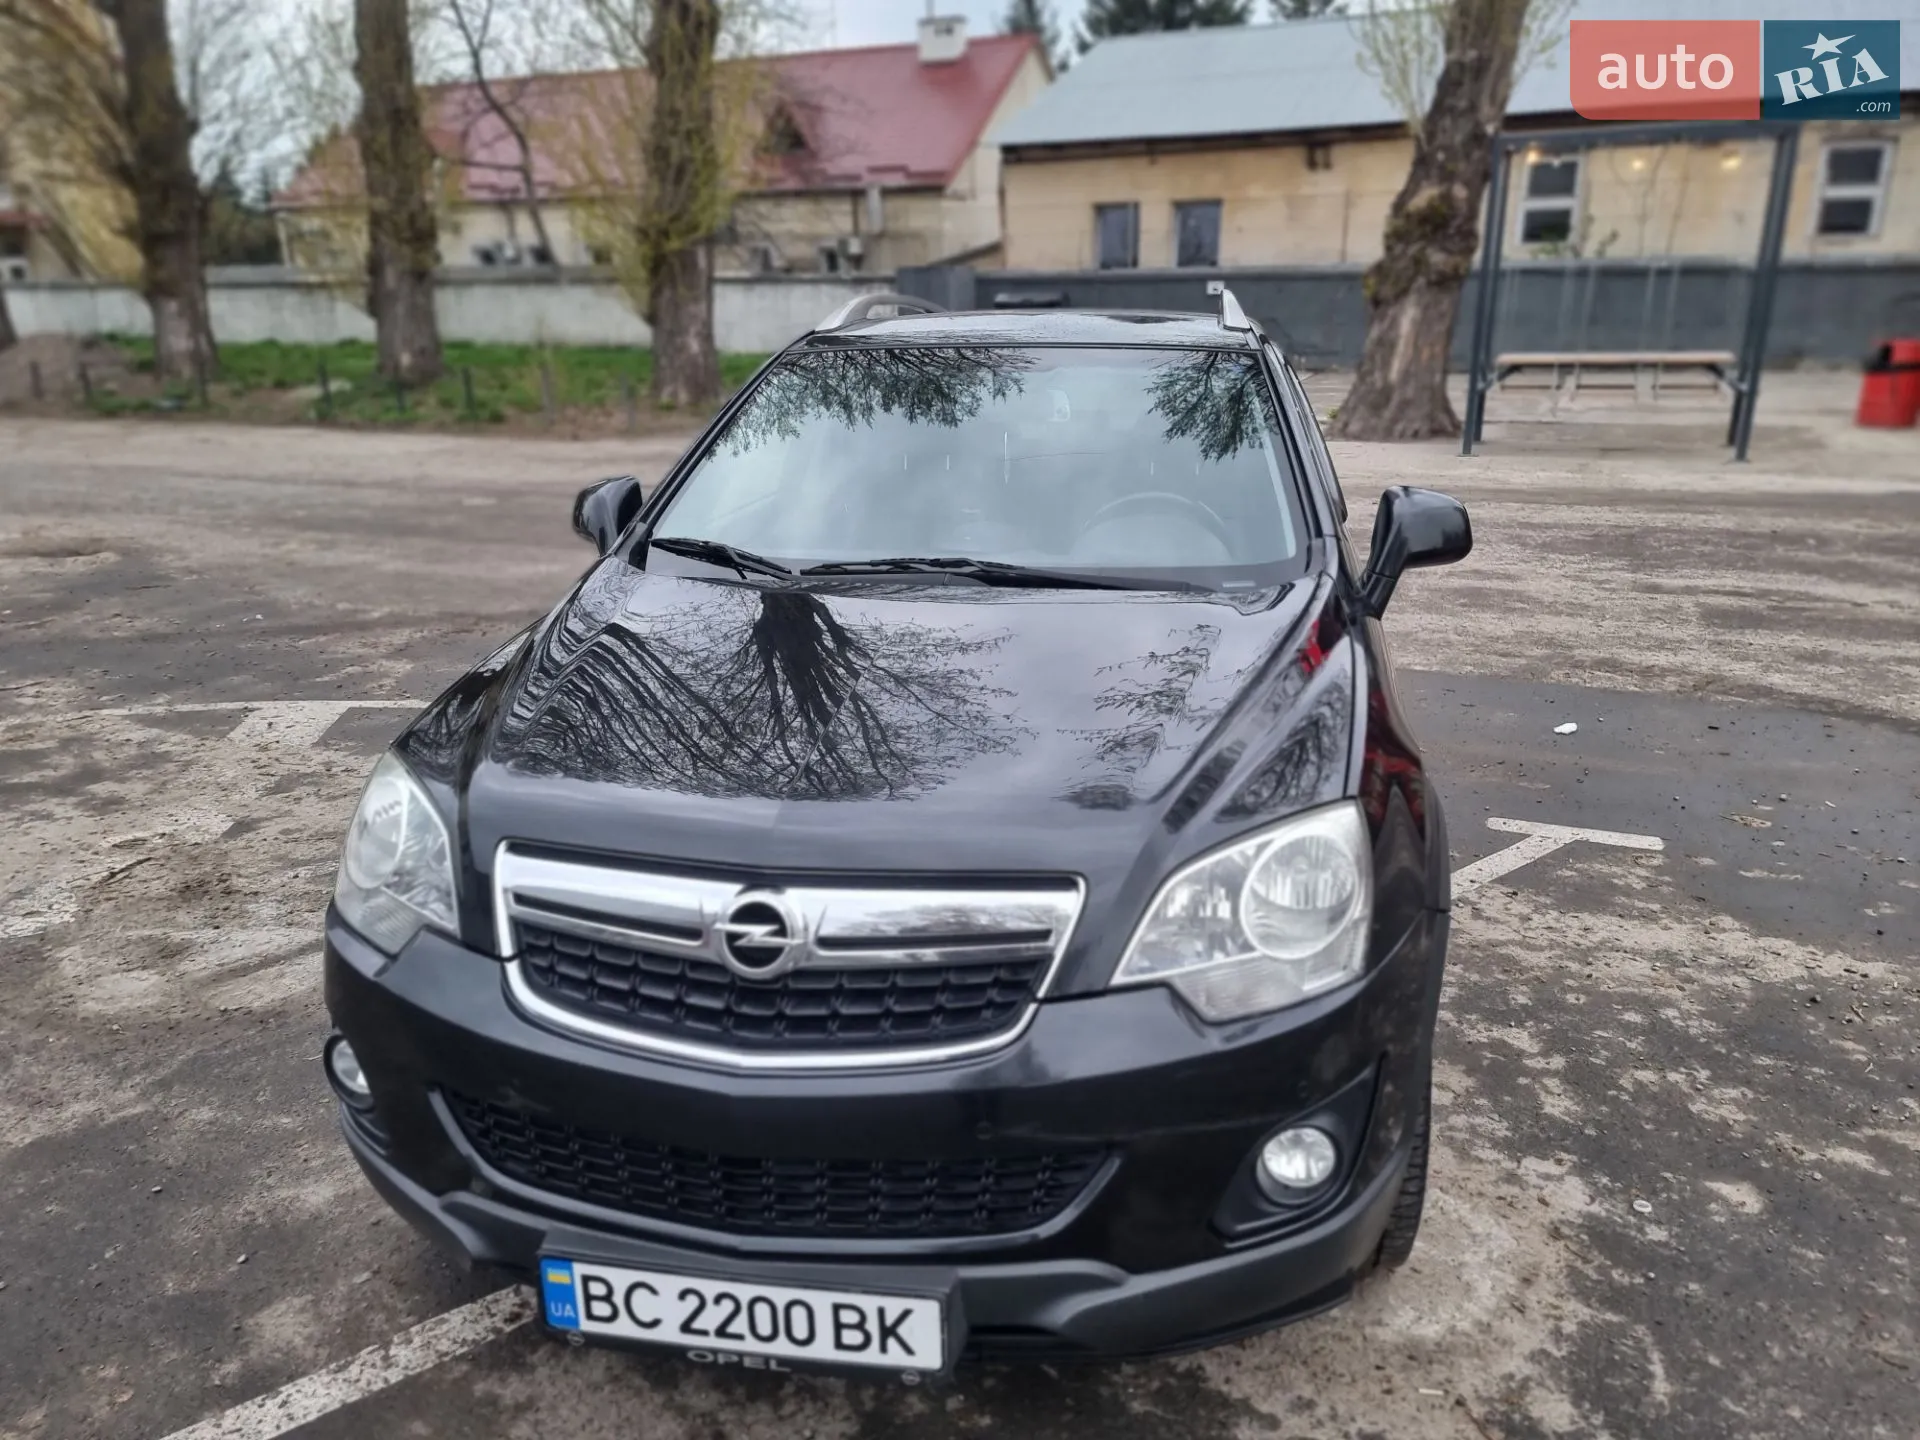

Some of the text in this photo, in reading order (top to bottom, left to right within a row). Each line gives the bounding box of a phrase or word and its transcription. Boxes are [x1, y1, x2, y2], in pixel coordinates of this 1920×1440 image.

[550, 1301, 576, 1319] UA
[581, 1273, 917, 1357] BC 2200 BK
[687, 1350, 791, 1372] OPEL
